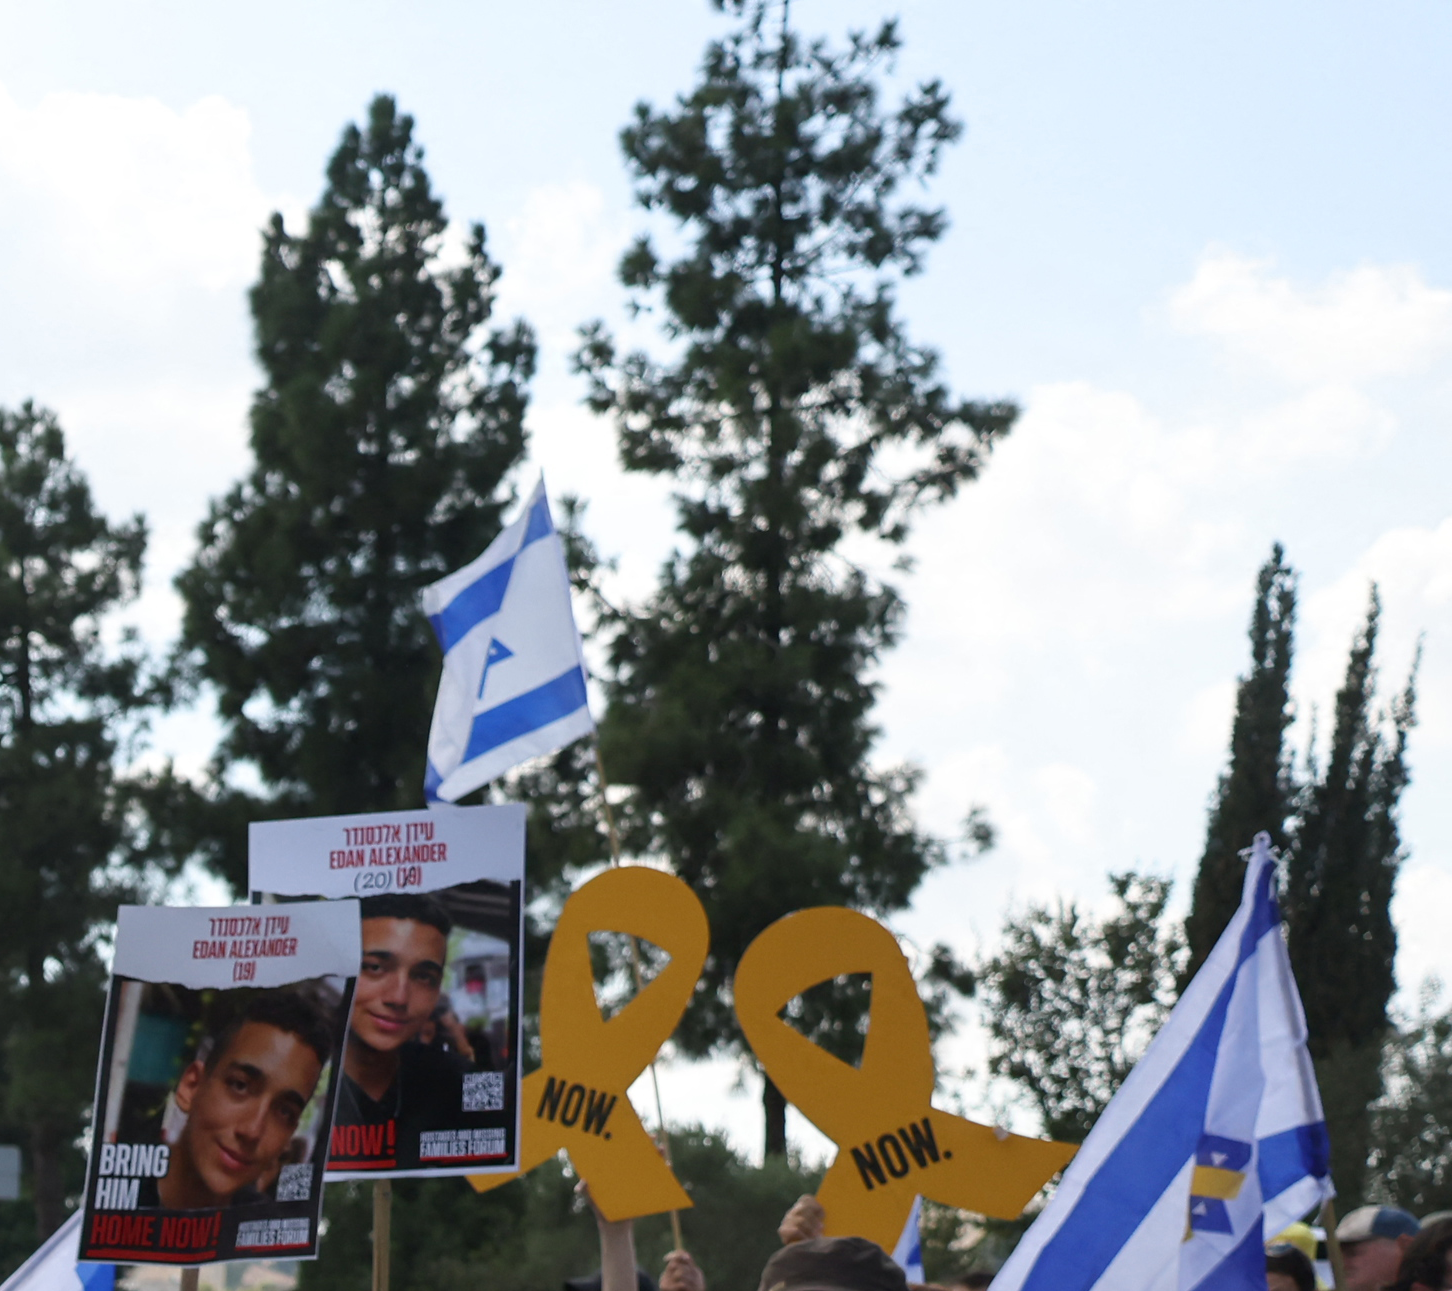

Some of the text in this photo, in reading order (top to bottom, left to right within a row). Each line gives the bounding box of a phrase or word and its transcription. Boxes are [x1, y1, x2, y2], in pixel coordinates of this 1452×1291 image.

[406, 821, 434, 843] עידן
[330, 843, 447, 869] EDAN ALEXANDER
[354, 869, 393, 892] (20)
[265, 916, 290, 937] עידן
[193, 937, 297, 959] EDAN ALEXANDER
[233, 960, 257, 982] (19)
[537, 1075, 618, 1140] NOW.
[331, 1119, 395, 1157] NOW!
[420, 1139, 506, 1157] FAMILIES FORUM
[99, 1143, 170, 1178] BRING
[851, 1117, 952, 1190] NOW.
[95, 1178, 141, 1211] HIM
[90, 1211, 222, 1249] HOME NOW!
[236, 1229, 310, 1247] FAMILIES FORUM
